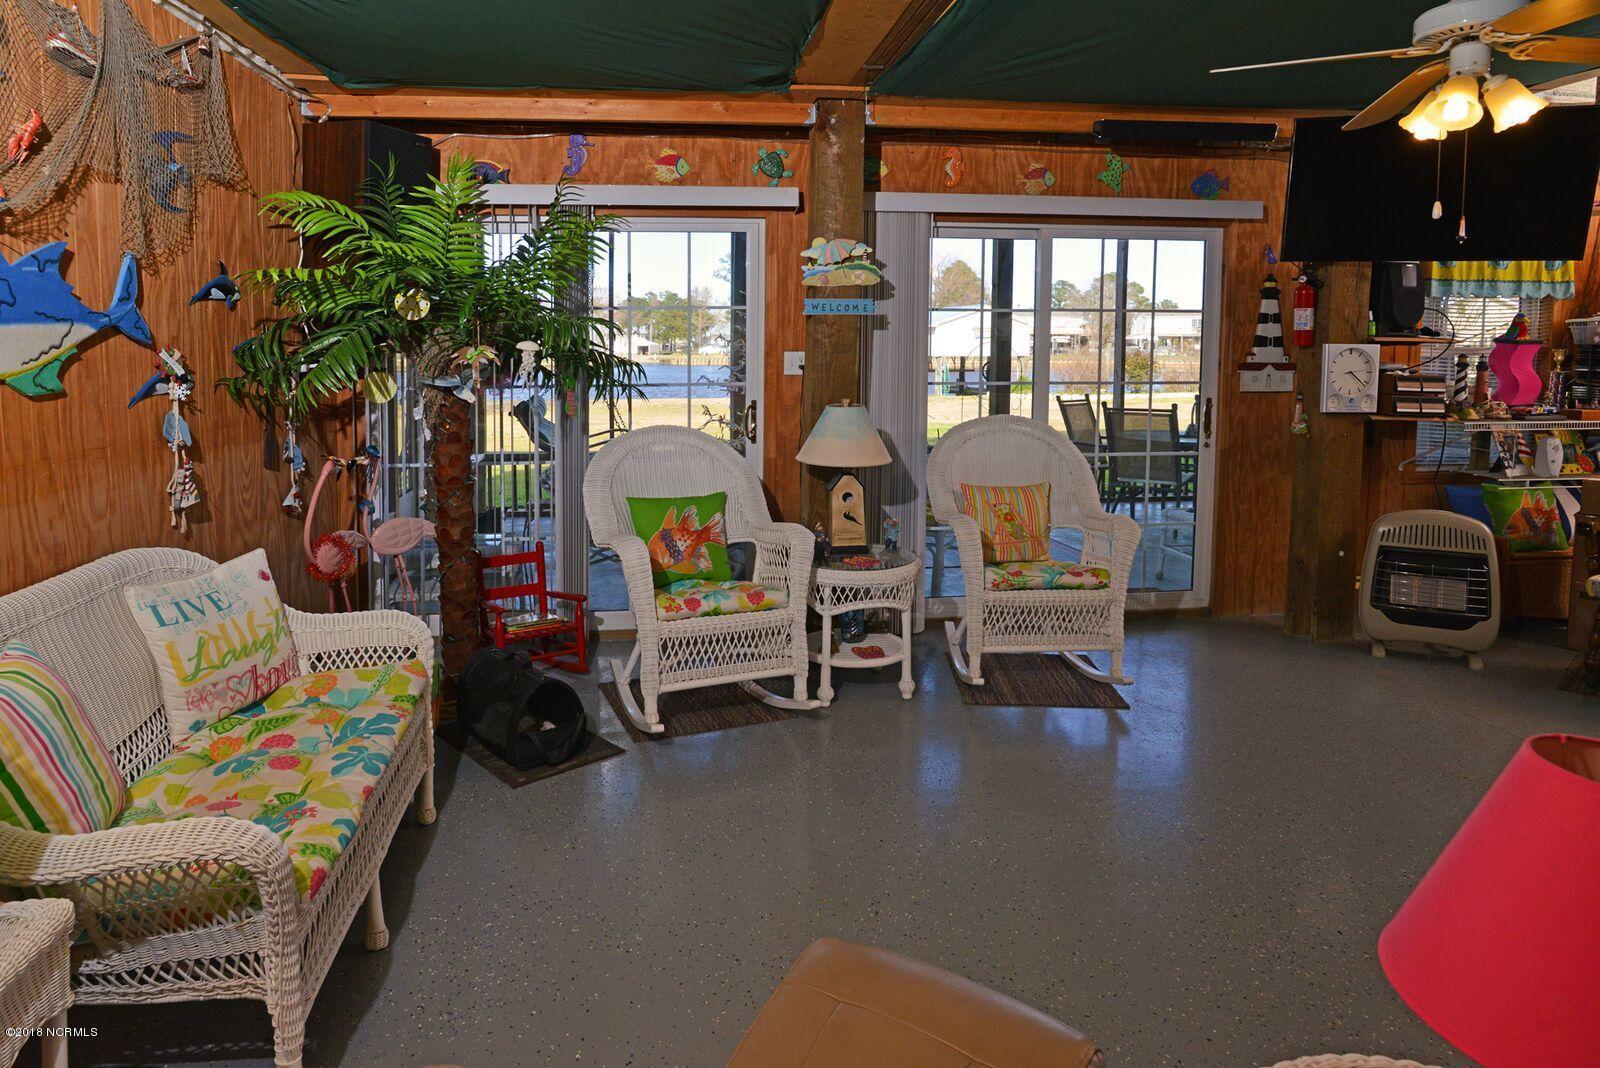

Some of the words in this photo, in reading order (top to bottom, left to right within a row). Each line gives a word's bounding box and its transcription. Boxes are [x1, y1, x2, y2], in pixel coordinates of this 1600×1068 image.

[811, 303, 869, 312] WELCOME
[145, 590, 232, 628] LIVE
[181, 608, 289, 682] Laugh
